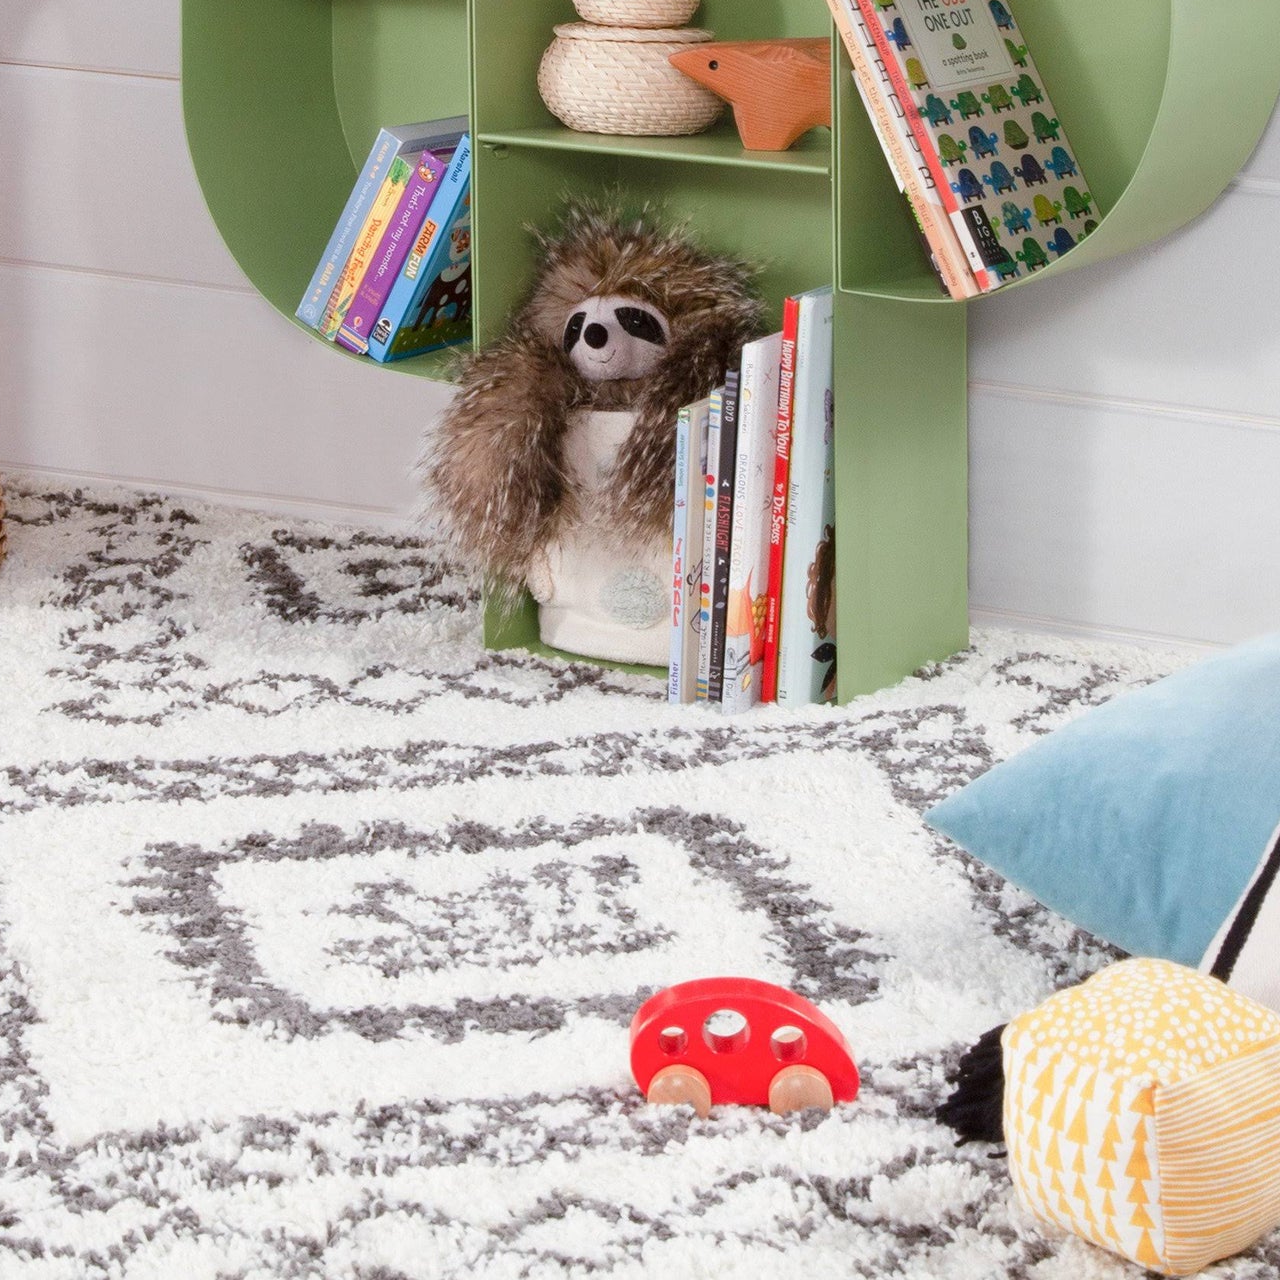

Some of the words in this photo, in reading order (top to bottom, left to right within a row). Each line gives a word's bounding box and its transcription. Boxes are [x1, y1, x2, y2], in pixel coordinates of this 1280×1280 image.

[924, 13, 950, 32] ONE
[949, 8, 975, 27] OUT
[948, 52, 975, 67] spotting
[974, 49, 989, 60] book
[844, 31, 863, 63] Don't
[858, 63, 871, 83] Let
[869, 86, 882, 107] the
[877, 104, 897, 144] Pigeon
[894, 146, 911, 179] Drive
[909, 178, 920, 200] the
[913, 121, 926, 138] OUT
[450, 147, 470, 184] Marshall
[408, 185, 426, 210] That's
[391, 224, 404, 242] my
[401, 209, 411, 228] not
[357, 218, 382, 257] Dancing
[415, 220, 436, 255] FARM
[319, 262, 335, 286] DADA
[345, 257, 364, 288] Feet!
[406, 254, 421, 279] FUN
[725, 399, 735, 422] BOYD
[736, 453, 747, 499] DRAGONS
[734, 503, 744, 532] LOVE
[772, 495, 784, 513] Dr.
[704, 518, 712, 541] HERE
[717, 494, 731, 552] FLASHLIGHT
[770, 515, 784, 544] Seuss
[702, 547, 710, 576] PRESS
[731, 537, 743, 572] TACOS
[669, 661, 678, 695] Fischer
